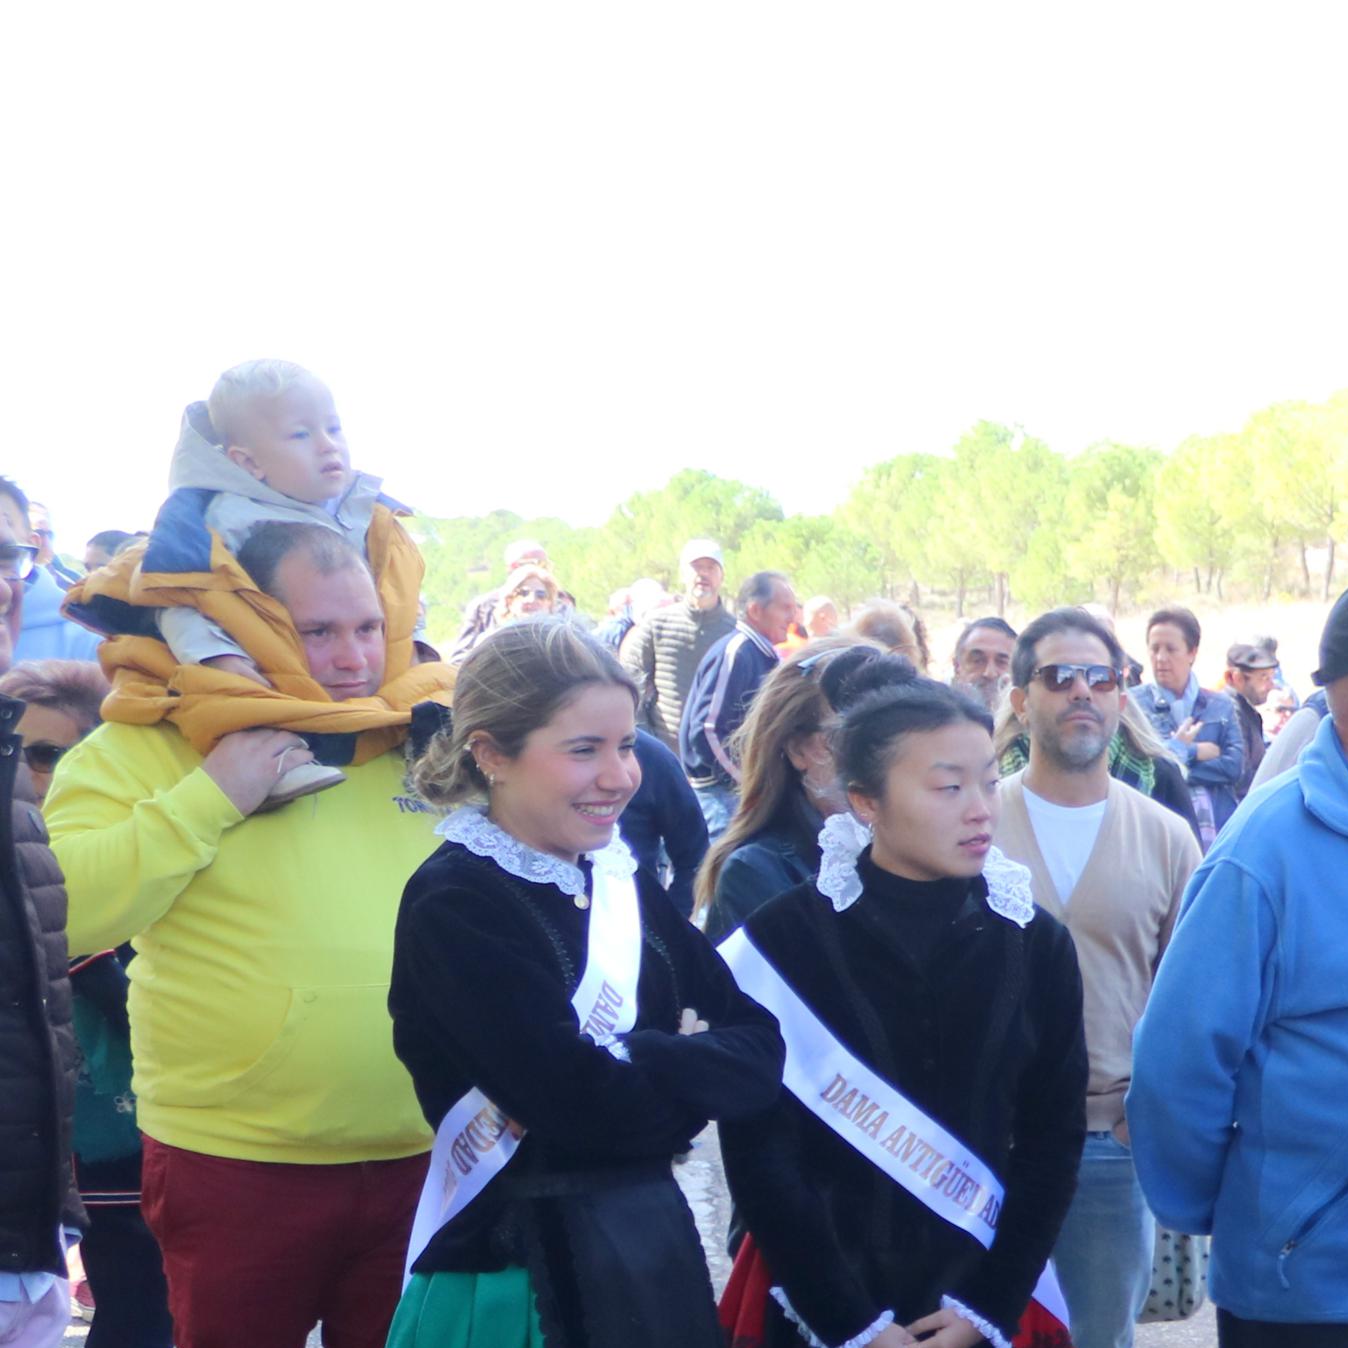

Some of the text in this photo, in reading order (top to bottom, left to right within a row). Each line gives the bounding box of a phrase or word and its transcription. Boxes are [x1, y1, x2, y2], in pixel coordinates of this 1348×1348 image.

[580, 980, 624, 1037] DAM
[450, 1106, 509, 1176] EDAD
[820, 1073, 1001, 1231] DAMA ANTIGÜEDAD
